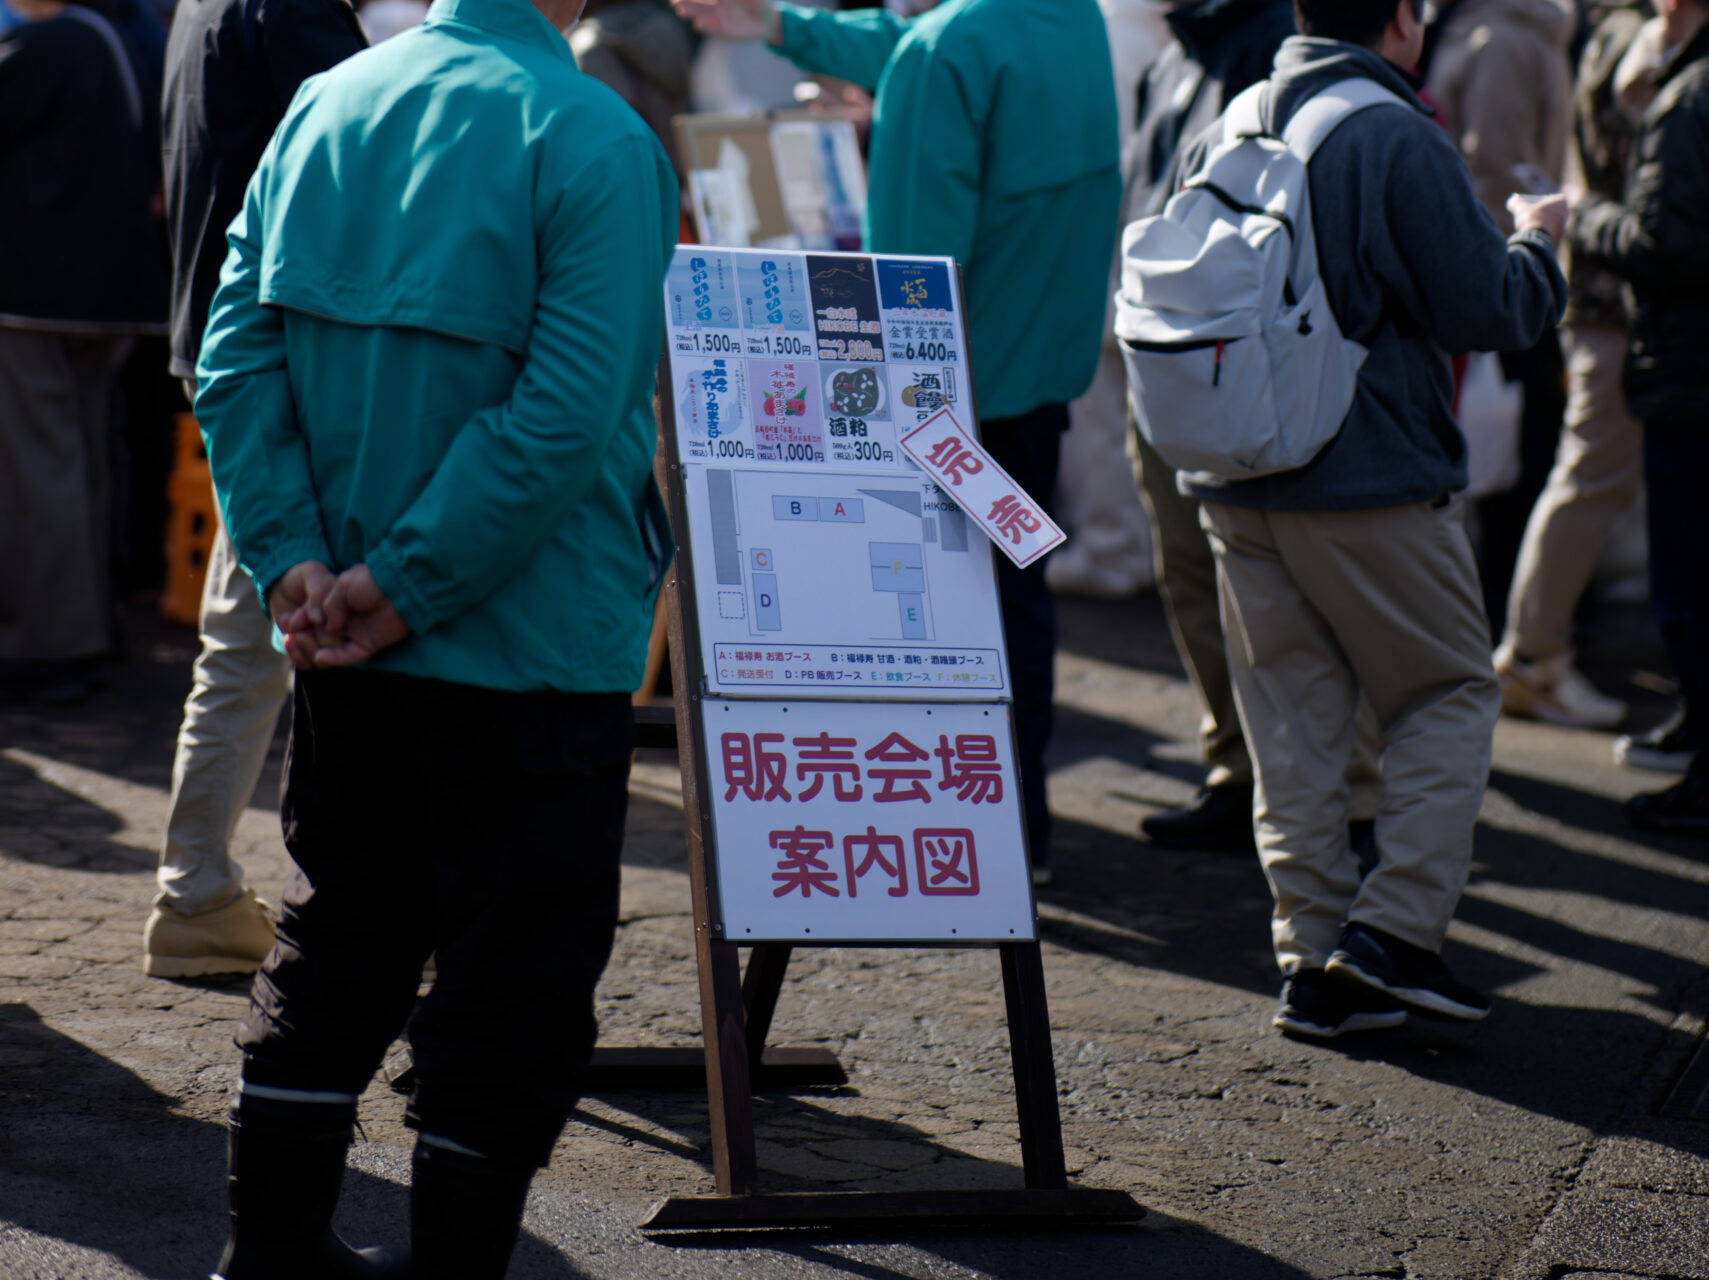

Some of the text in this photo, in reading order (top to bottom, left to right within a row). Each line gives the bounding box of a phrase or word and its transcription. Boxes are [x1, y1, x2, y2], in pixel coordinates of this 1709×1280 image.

[818, 320, 858, 332] HIKOBE
[889, 325, 954, 340] 金賞受賞酒
[694, 333, 741, 353] 1,500円
[764, 335, 812, 356] 1,500円
[838, 339, 883, 361] 2,800円
[829, 416, 868, 437] 酒粕
[708, 440, 754, 459] 1,000円
[776, 443, 824, 462] 1,000円
[855, 441, 893, 462] 300円
[924, 436, 1042, 545] 完売
[791, 501, 802, 515] B
[834, 502, 846, 516] A
[755, 552, 768, 566] C
[893, 561, 903, 575] F
[760, 593, 772, 608] D
[907, 608, 917, 622] E
[721, 731, 1004, 805] 販売会場
[769, 825, 980, 899] 案内図
